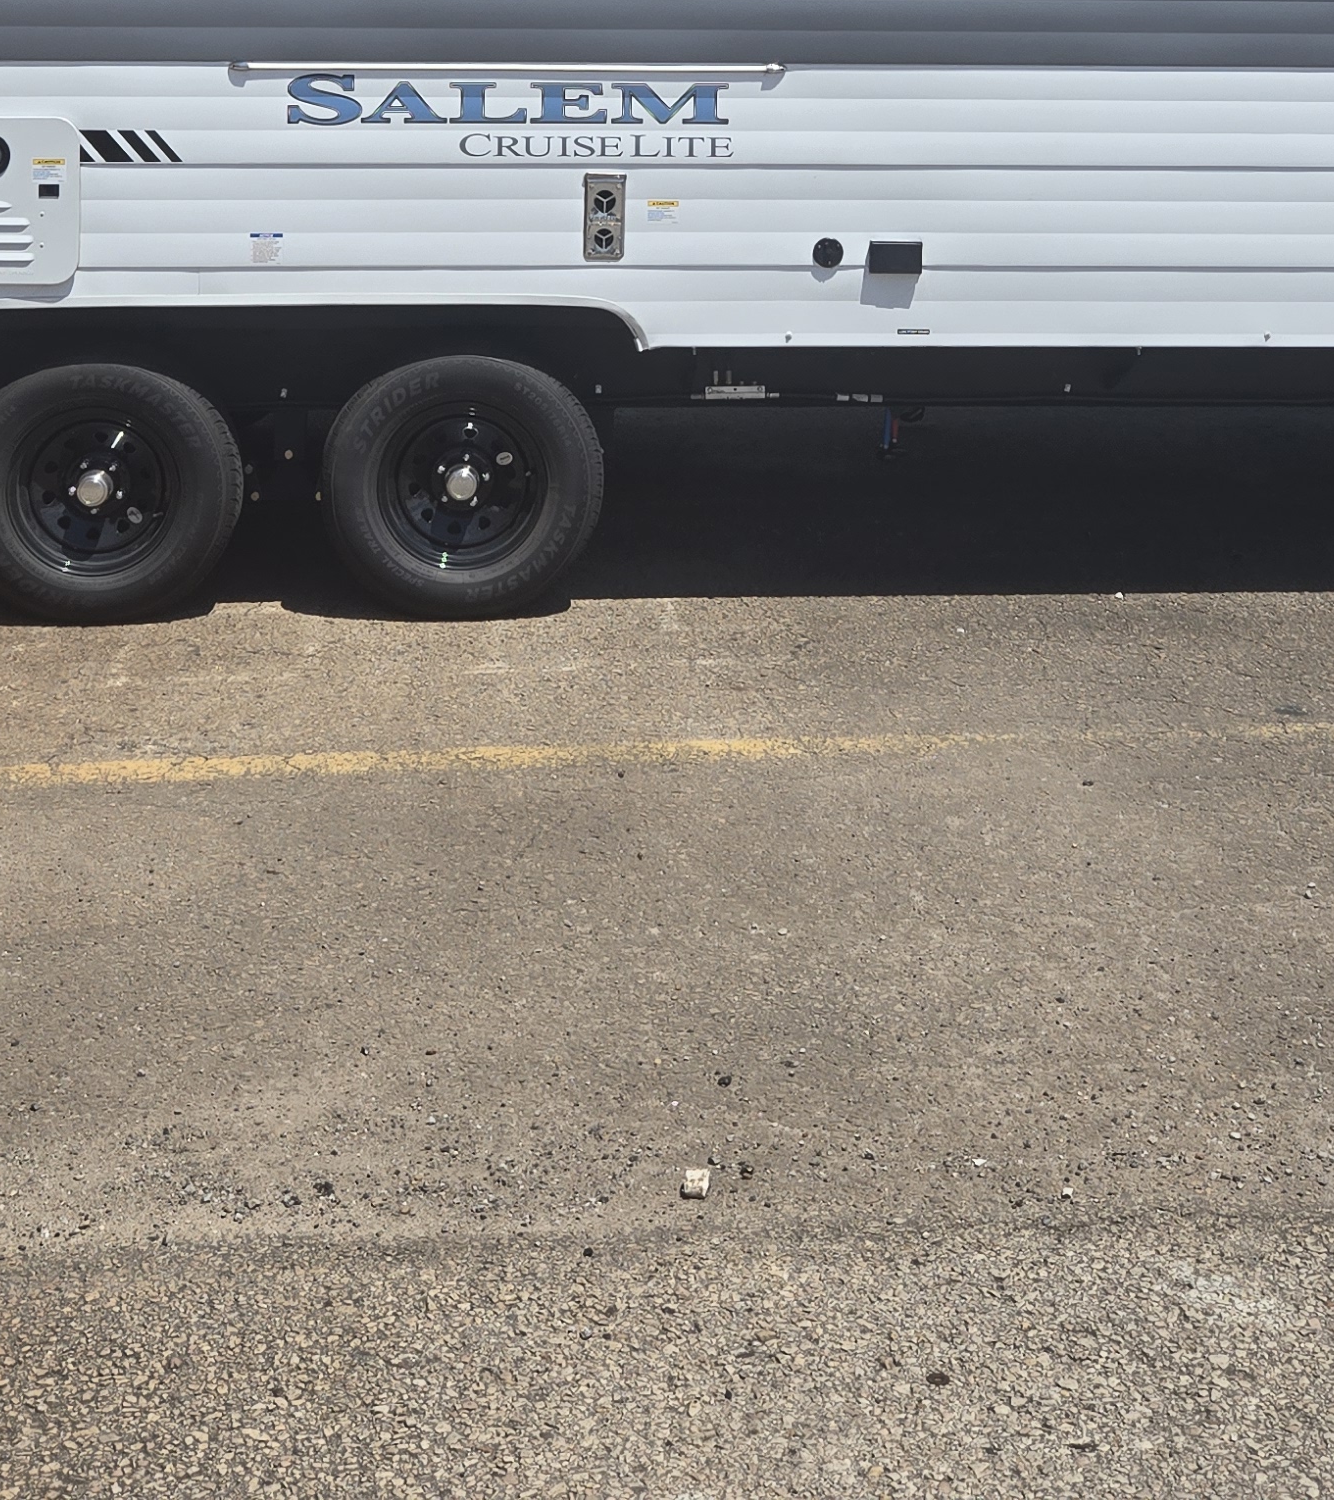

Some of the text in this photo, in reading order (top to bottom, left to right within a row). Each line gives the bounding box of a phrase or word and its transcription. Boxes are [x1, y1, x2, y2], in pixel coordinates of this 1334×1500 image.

[286, 74, 729, 126] SALEM
[69, 373, 203, 449] TASKMASTER
[353, 372, 441, 453] STRIDER
[467, 503, 578, 601] TASKMASTER
